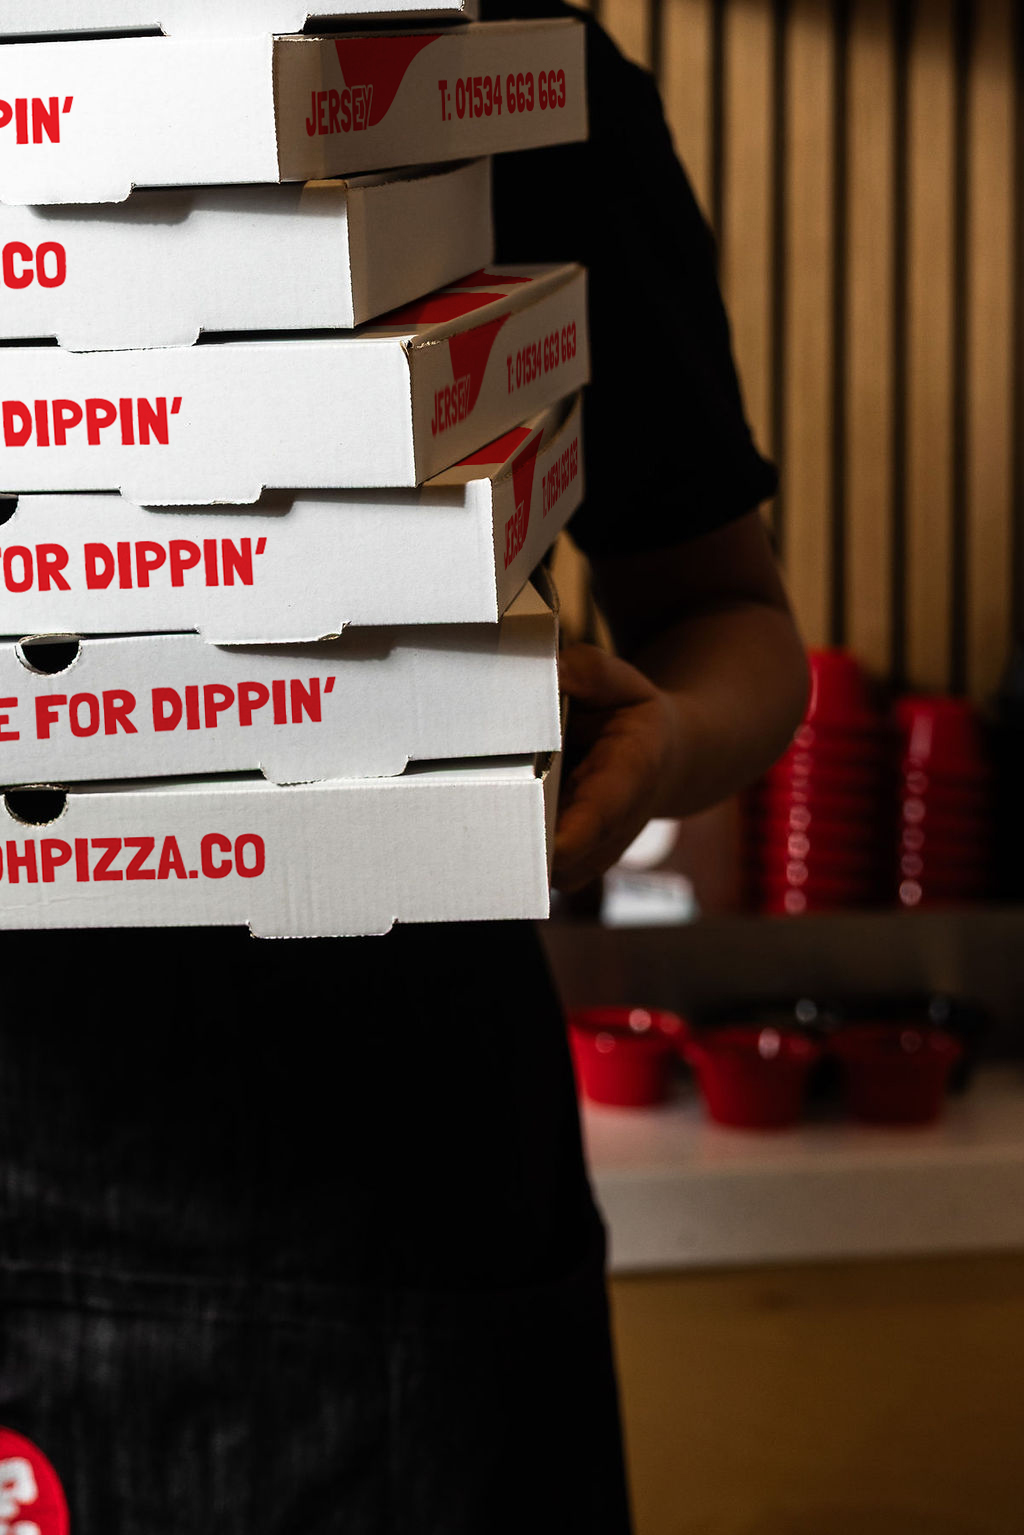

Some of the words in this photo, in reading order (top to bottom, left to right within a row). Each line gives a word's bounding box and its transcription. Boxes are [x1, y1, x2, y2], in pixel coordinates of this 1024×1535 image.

[305, 84, 373, 137] JERSEY
[438, 79, 452, 121] T:
[455, 75, 502, 119] 01534
[506, 71, 534, 114] 663
[538, 68, 566, 110] 663
[507, 353, 514, 396] T:
[516, 340, 542, 389] 01534
[543, 329, 559, 374] 663
[561, 321, 576, 363] 663
[1, 396, 183, 448] DIPPIN'
[431, 373, 471, 438] JERSEY
[83, 536, 268, 591] DIPPIN'
[34, 688, 139, 740] FOR
[151, 675, 337, 733] DIPPIN'
